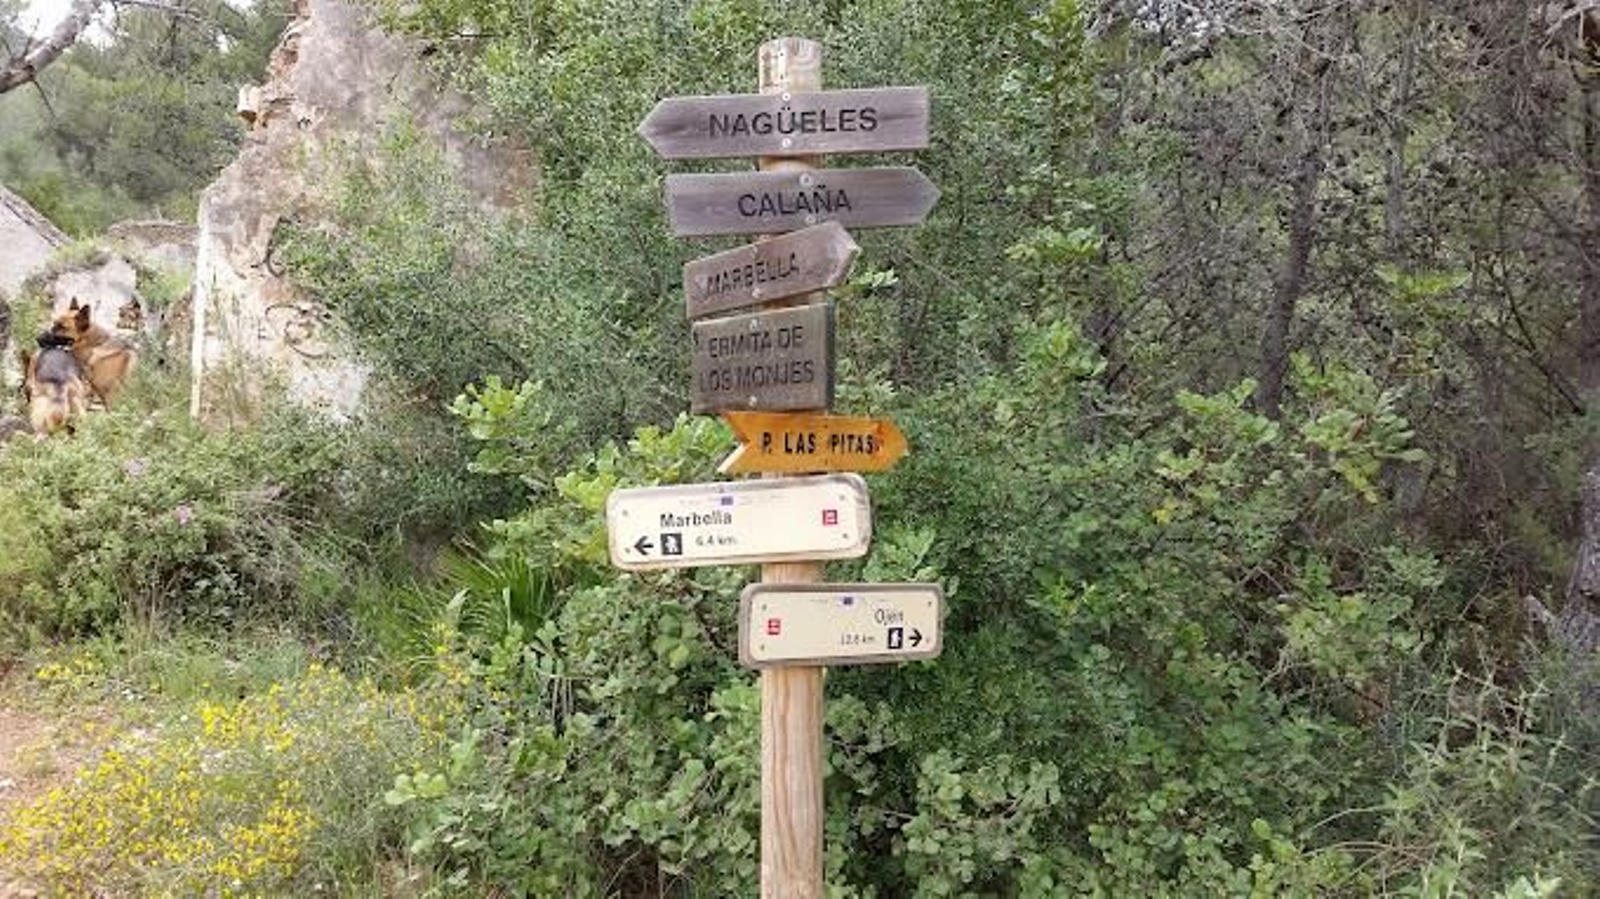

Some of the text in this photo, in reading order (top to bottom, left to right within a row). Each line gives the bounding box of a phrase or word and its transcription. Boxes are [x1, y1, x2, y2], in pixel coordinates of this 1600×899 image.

[708, 106, 878, 138] NAGÜELES
[737, 185, 852, 217] CALAÑA
[706, 252, 800, 296] MARBELLA
[709, 326, 804, 358] ERMITA DE
[699, 360, 814, 393] LOS MONJES
[761, 432, 874, 454] P. LAS PITAS
[660, 510, 732, 528] Marbella
